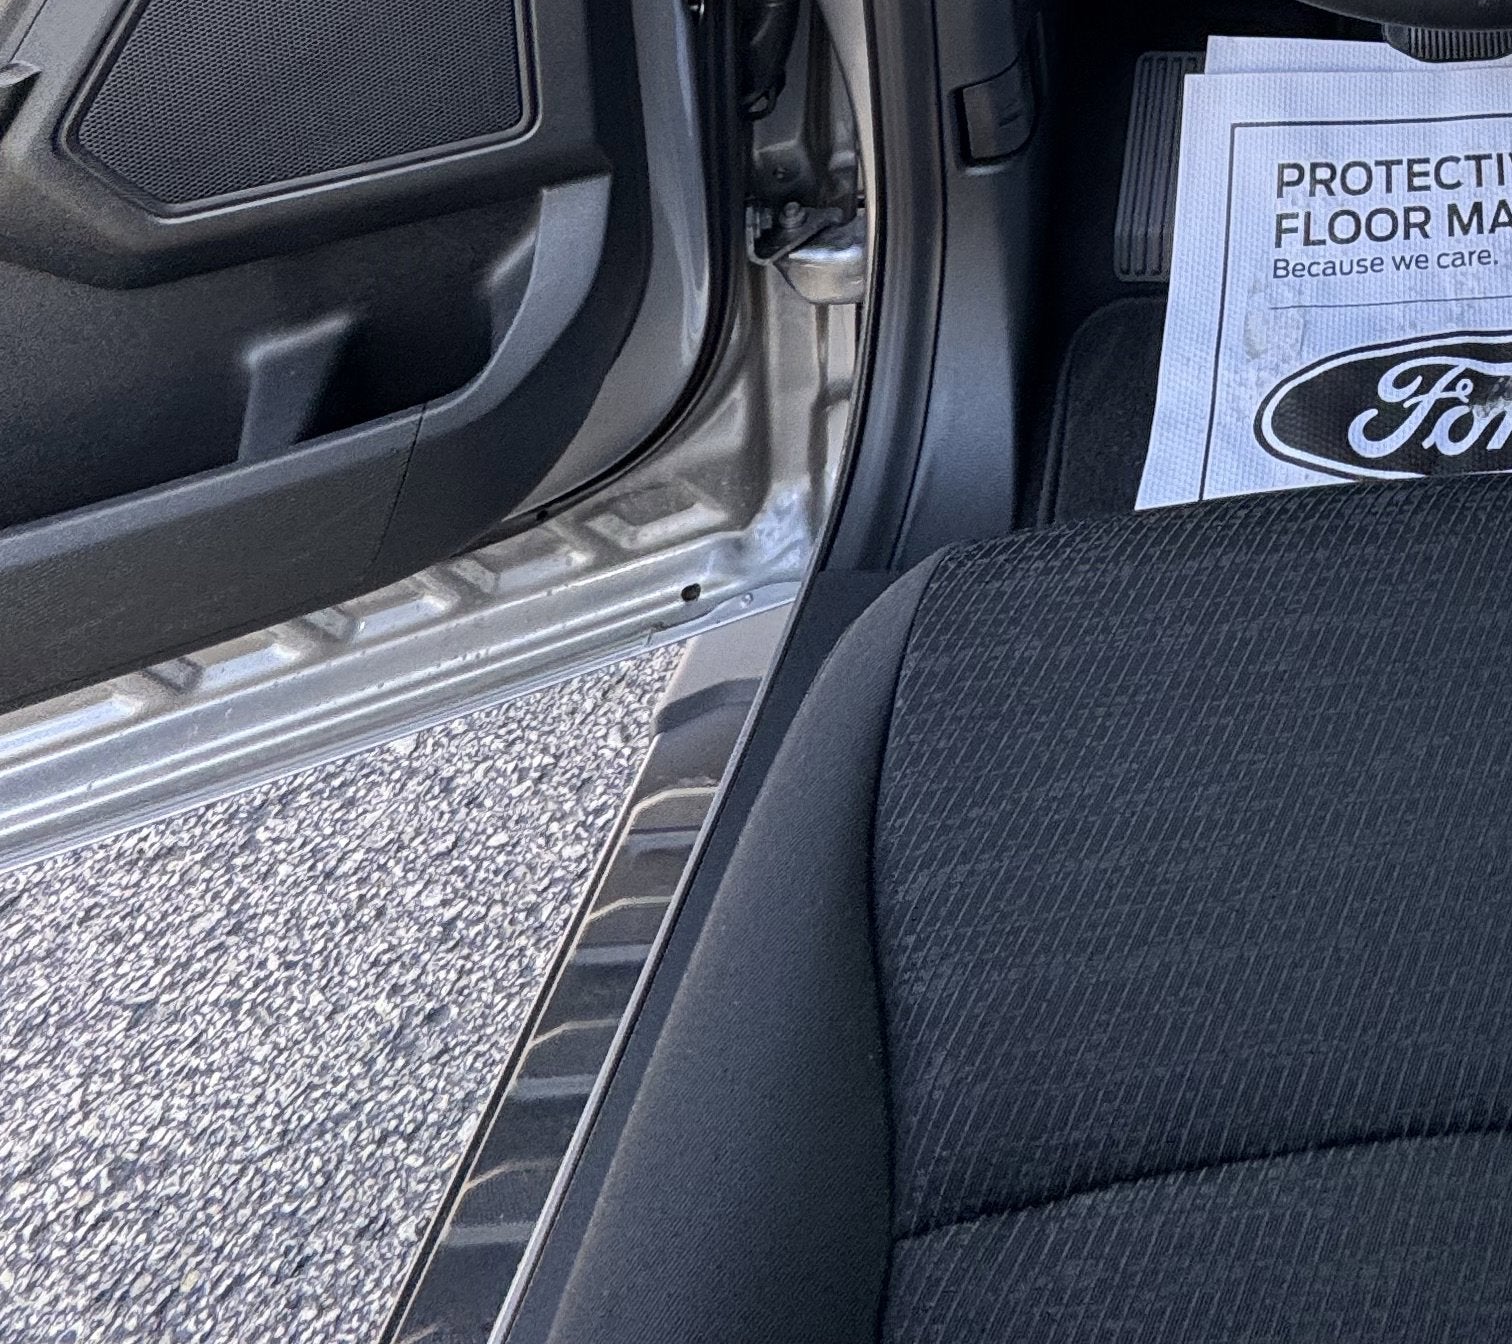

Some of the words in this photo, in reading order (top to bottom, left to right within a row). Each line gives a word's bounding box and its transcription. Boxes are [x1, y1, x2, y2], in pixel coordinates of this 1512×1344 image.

[1273, 202, 1433, 250] FLOOR
[1272, 253, 1385, 280] Because
[1392, 251, 1430, 272] we
[1436, 248, 1500, 270] care.
